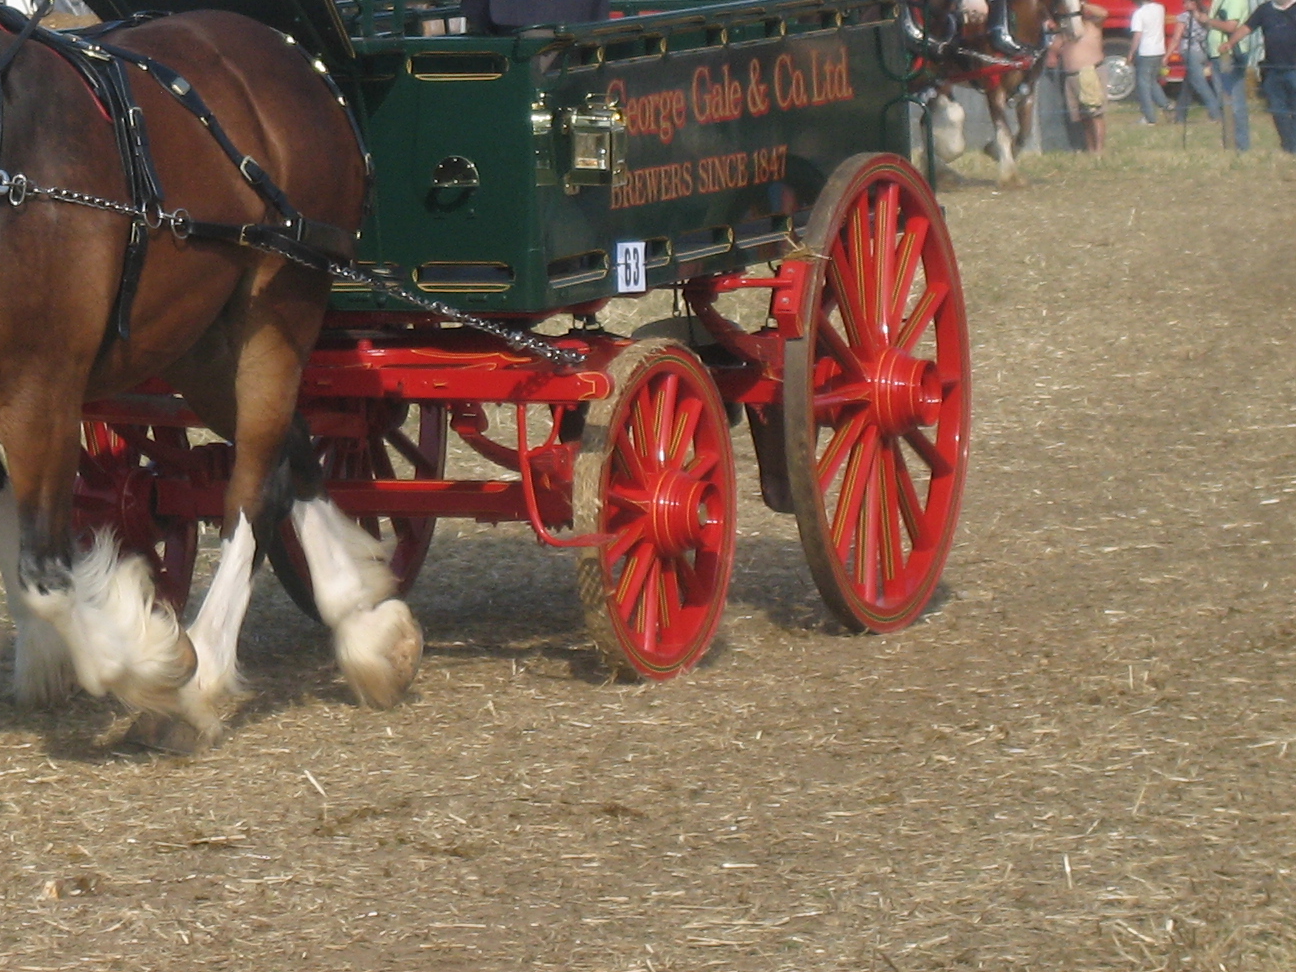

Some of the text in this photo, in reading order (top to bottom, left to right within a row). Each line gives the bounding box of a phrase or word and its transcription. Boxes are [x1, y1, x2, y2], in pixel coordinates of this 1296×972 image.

[691, 64, 743, 124] Gale
[747, 58, 770, 117] &
[774, 53, 807, 111] Co.
[811, 46, 853, 106] Ltd.
[611, 144, 788, 210] BREWERS SINCE 1847
[624, 247, 640, 288] 63
